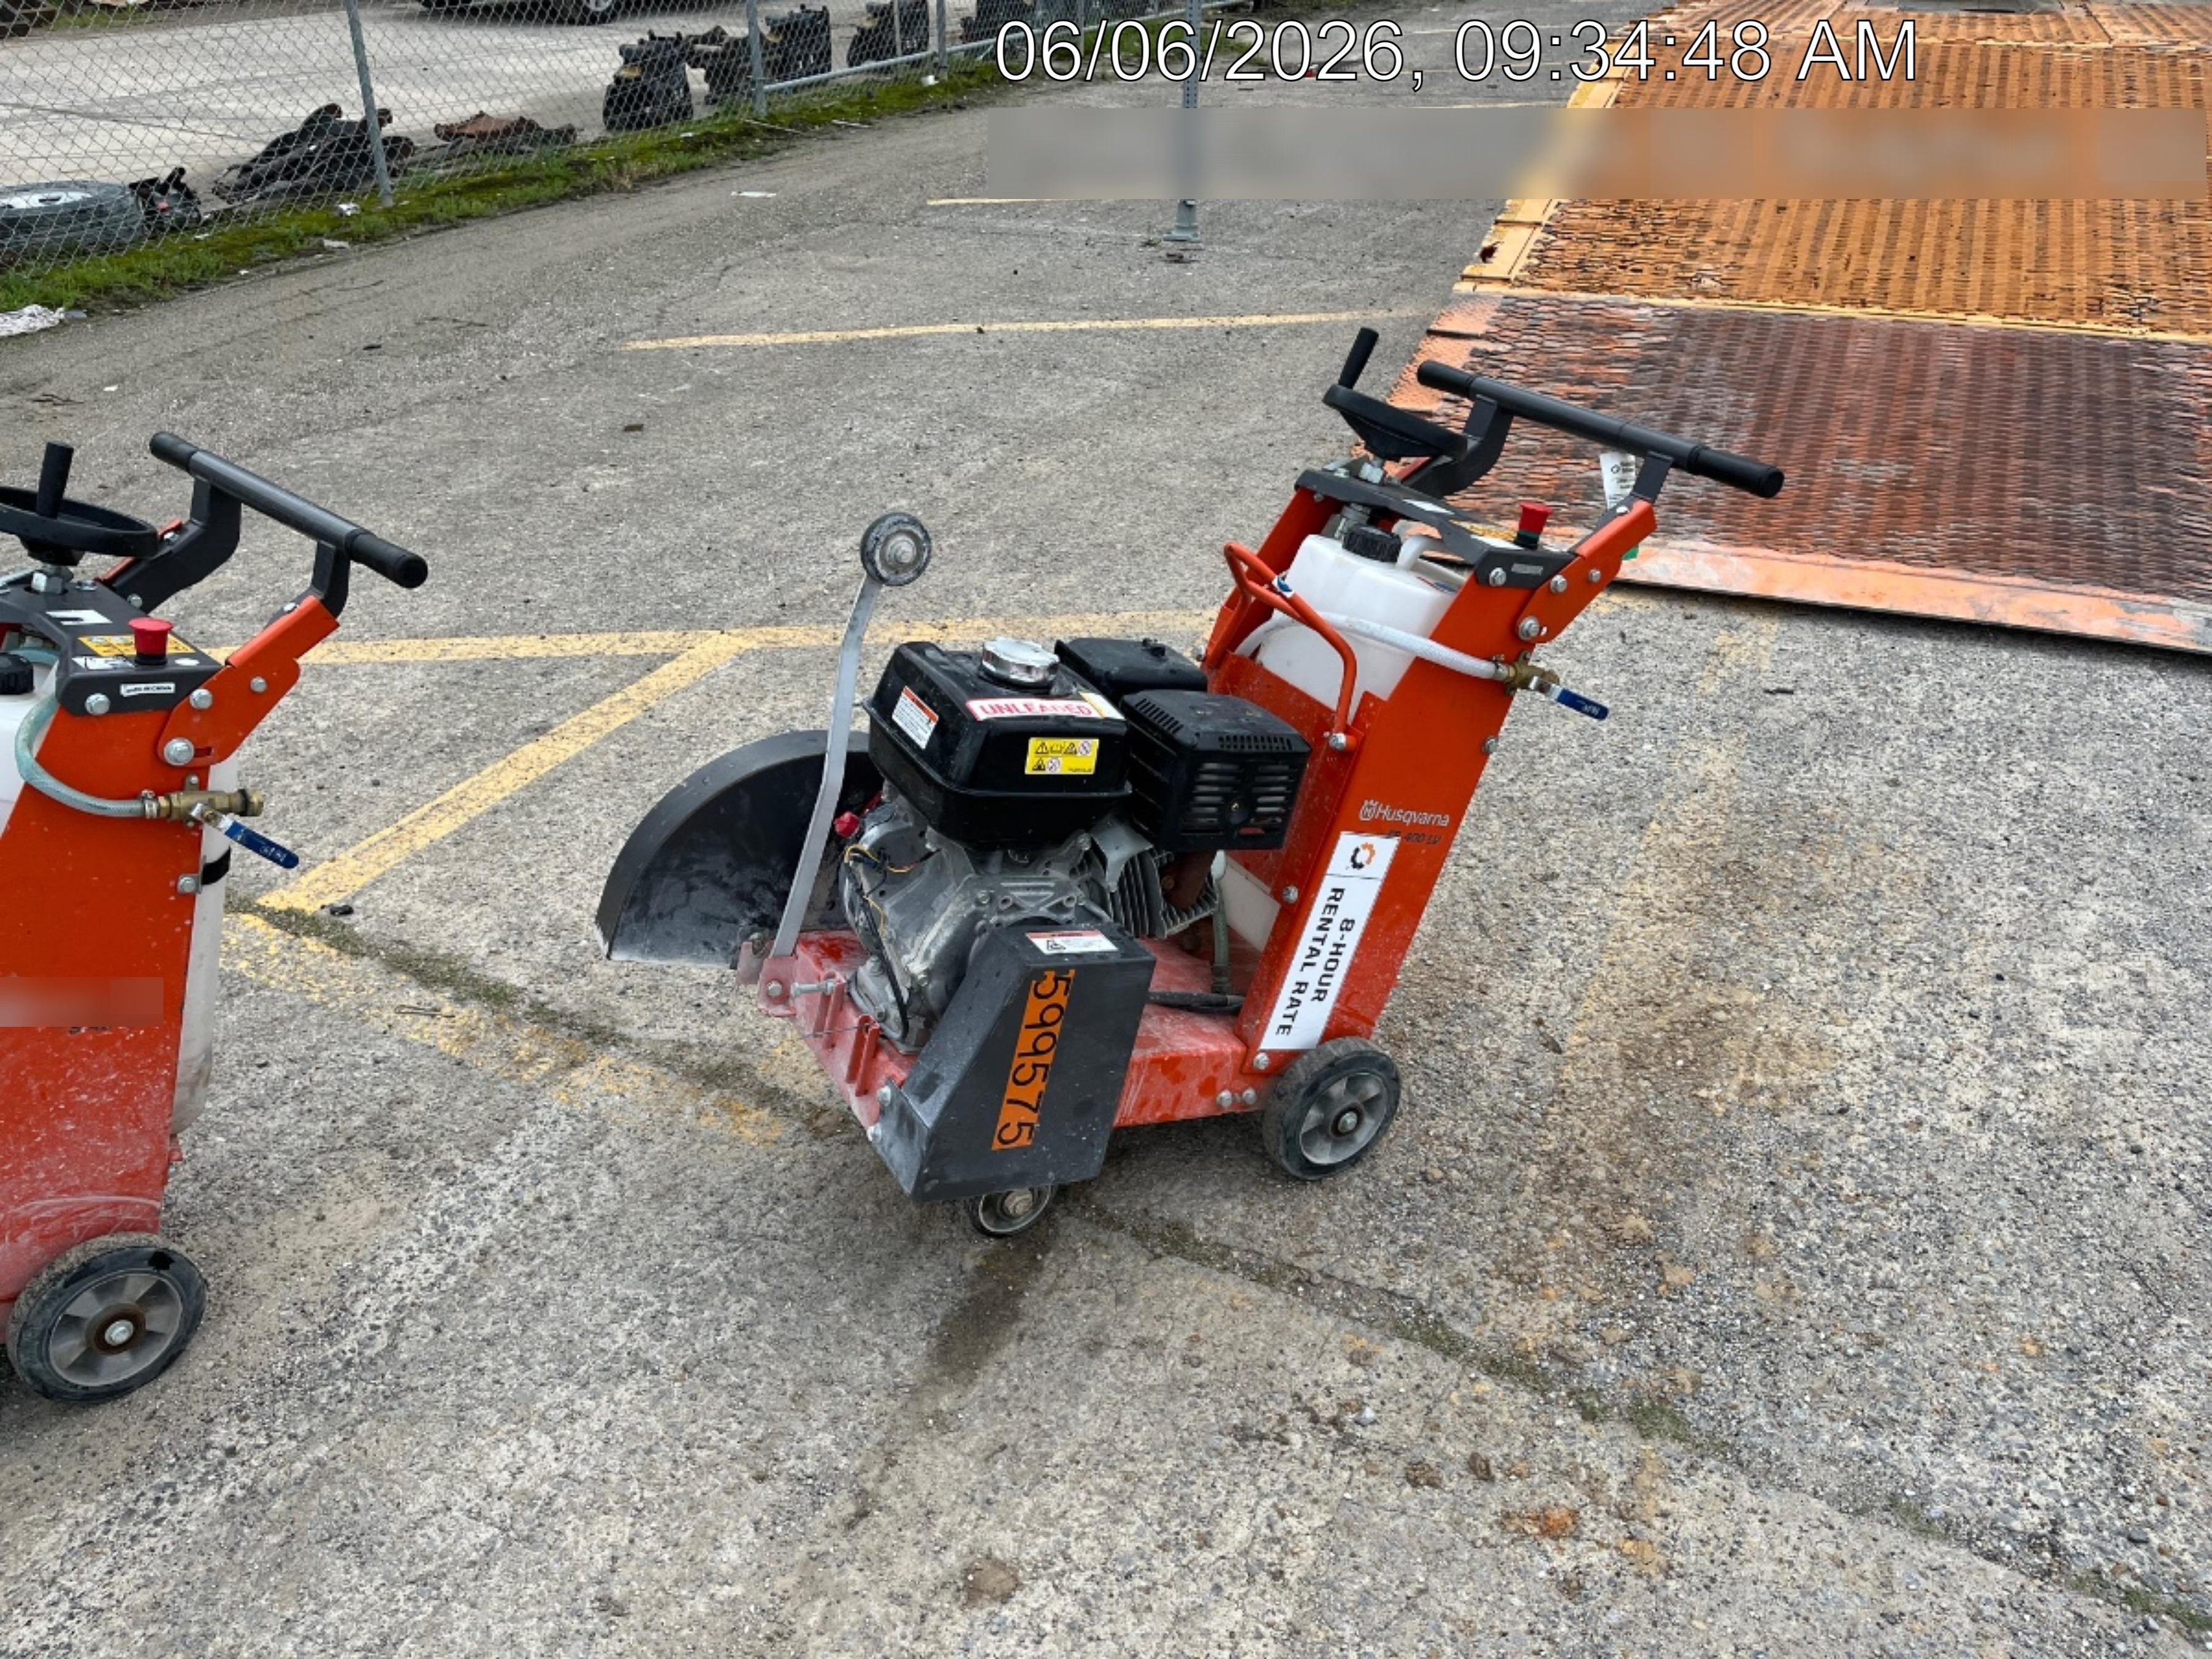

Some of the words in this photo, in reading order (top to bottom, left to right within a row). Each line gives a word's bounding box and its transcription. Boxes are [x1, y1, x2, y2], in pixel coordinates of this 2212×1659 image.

[1375, 804, 1449, 826] Husqvarna
[1299, 887, 1346, 972] RENTAL
[1310, 918, 1355, 1002] 8-HOUR
[1276, 981, 1309, 1036] RATE
[997, 975, 1072, 1145] 599575
